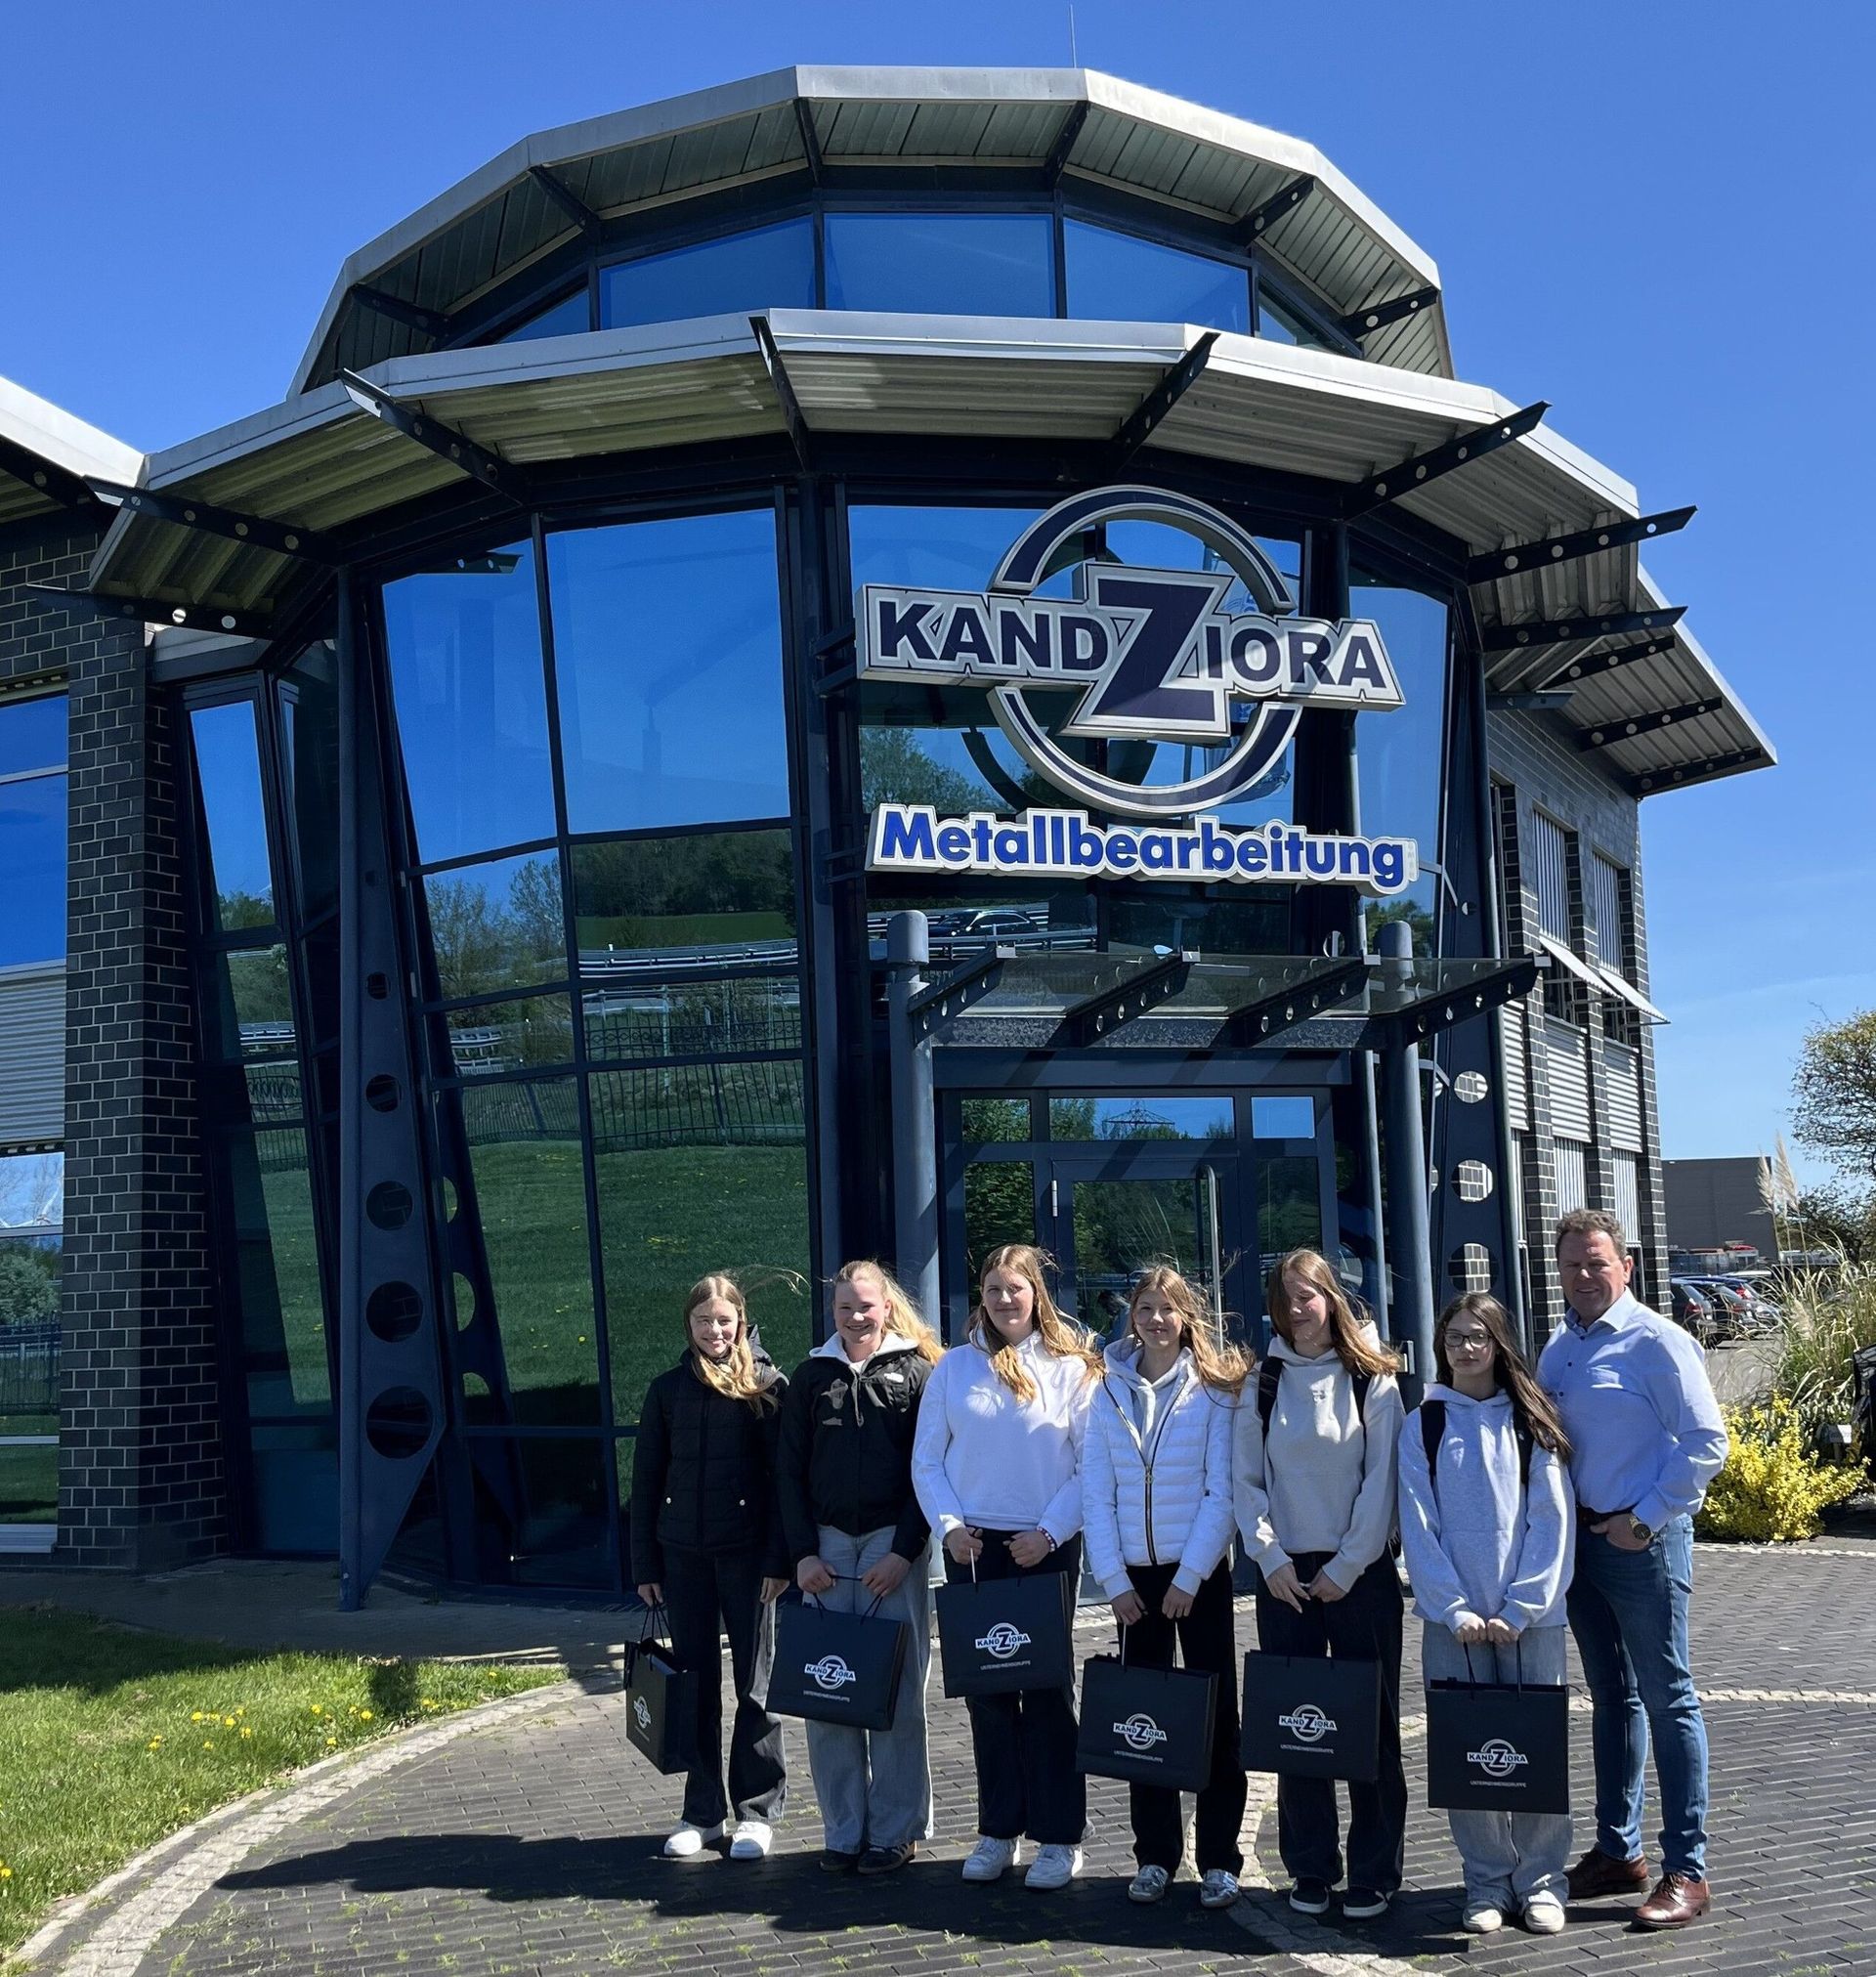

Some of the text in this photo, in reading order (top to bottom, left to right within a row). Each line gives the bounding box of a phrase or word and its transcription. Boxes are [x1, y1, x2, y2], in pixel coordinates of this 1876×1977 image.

[879, 579, 1386, 721] KANDZIORA
[881, 811, 1403, 887] Metallbearbeitung
[1468, 1749, 1527, 1767] KANDZIORA
